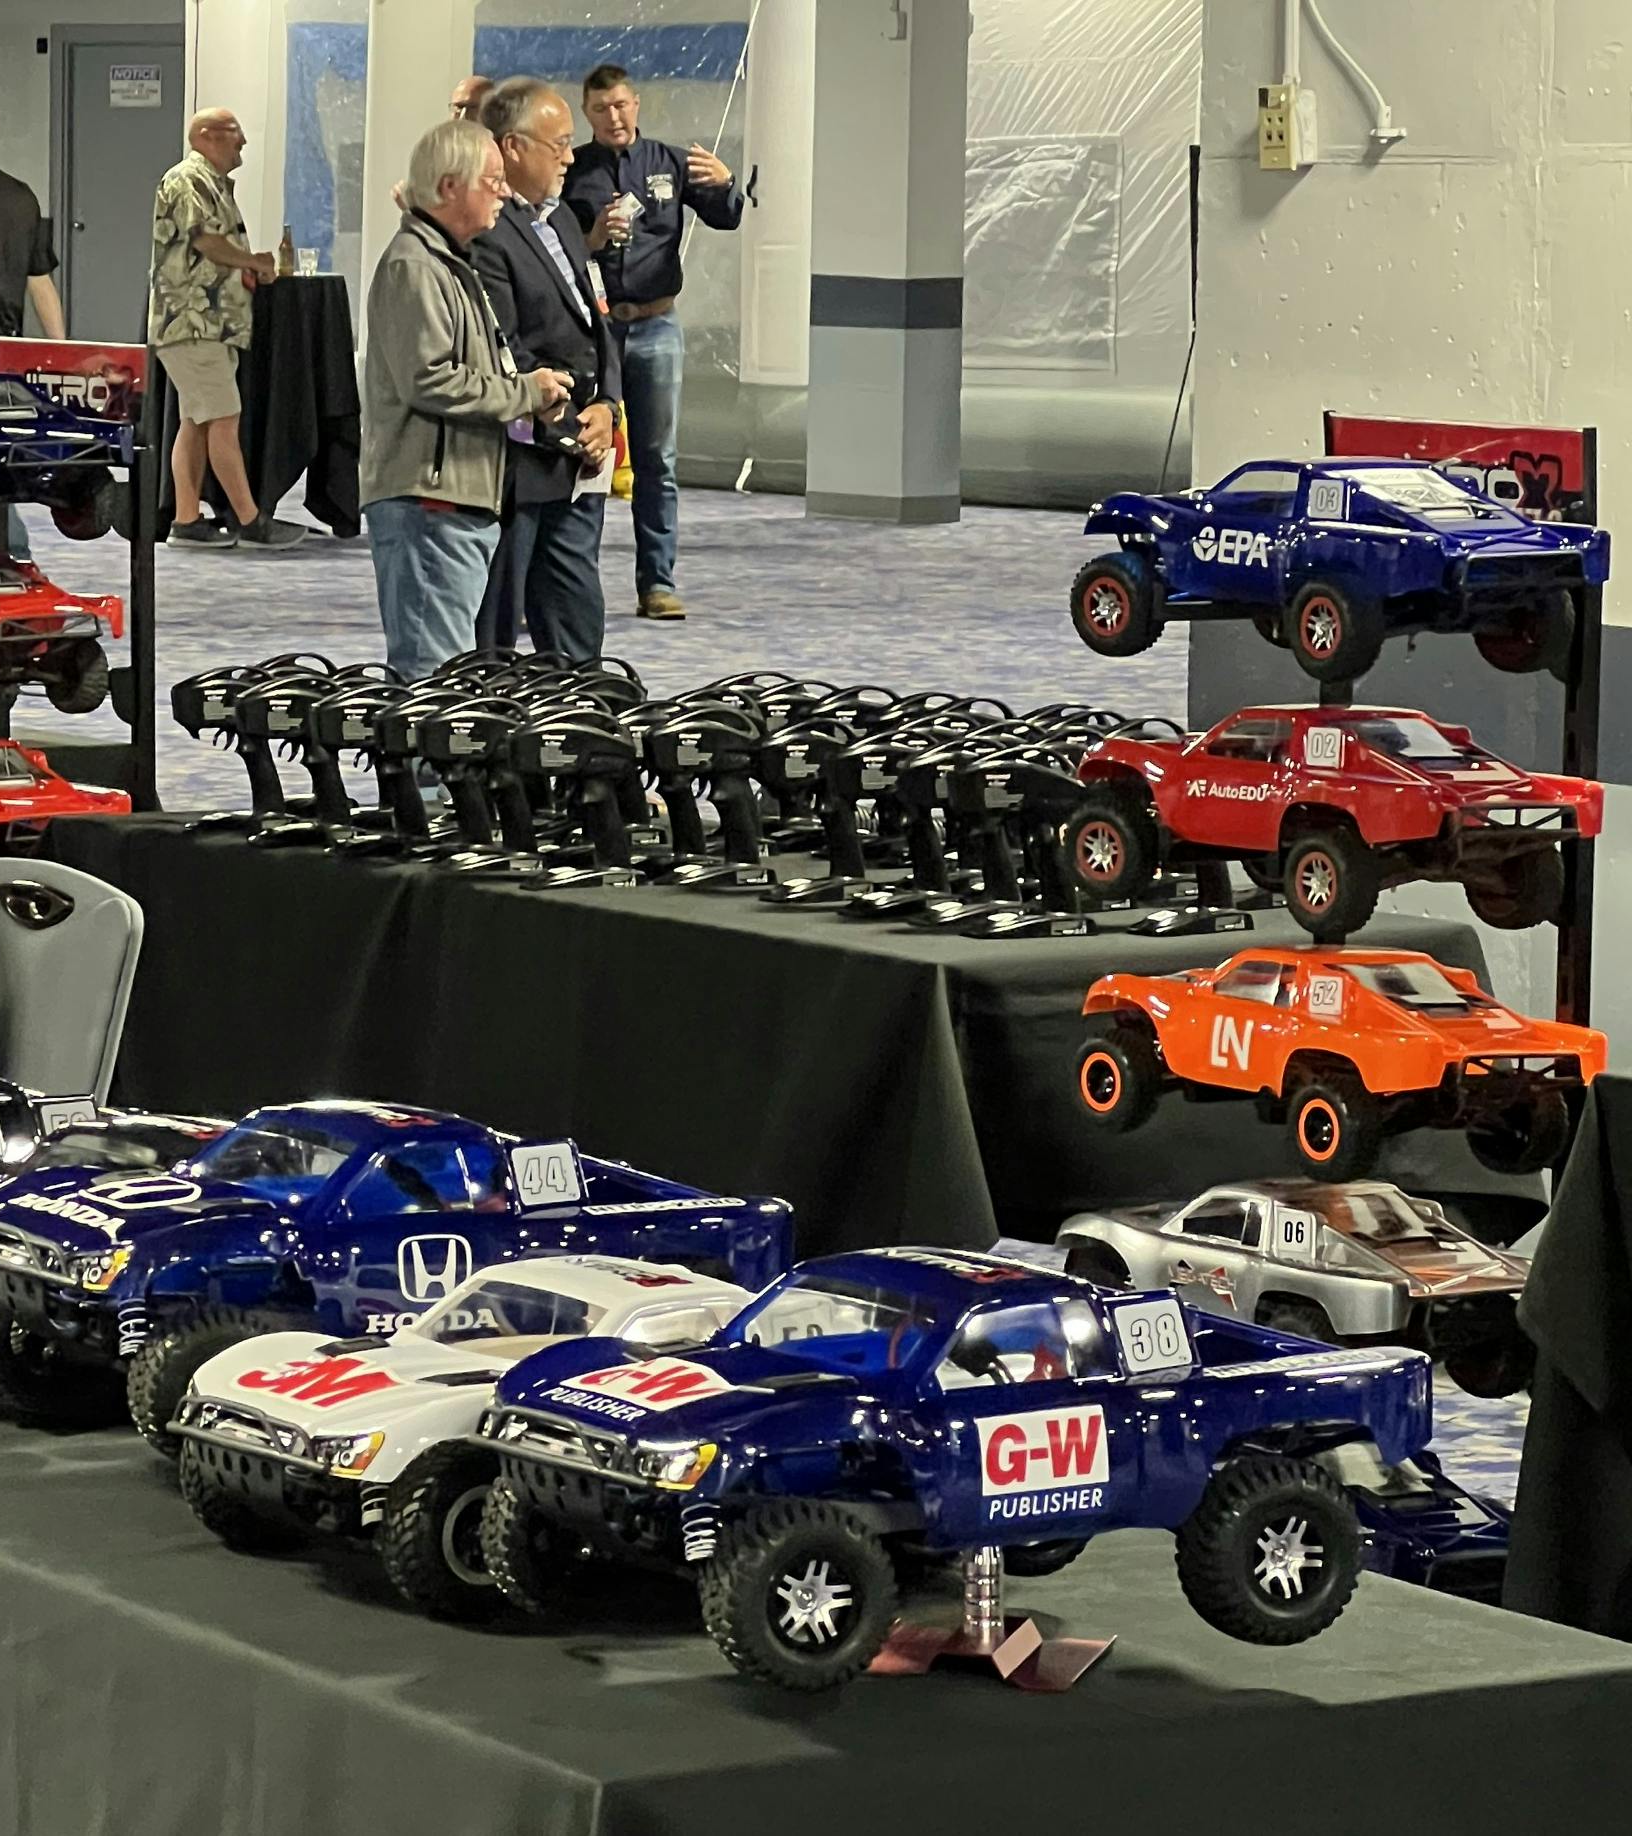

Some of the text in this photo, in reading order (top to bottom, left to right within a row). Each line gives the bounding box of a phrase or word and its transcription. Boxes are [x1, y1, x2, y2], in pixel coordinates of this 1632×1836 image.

[1315, 485, 1339, 513] 03
[1217, 530, 1270, 568] EPA
[1310, 731, 1336, 759] 02
[1311, 980, 1338, 1006] 52
[521, 1156, 568, 1195] 44
[8, 1192, 126, 1244] HONDA
[1284, 1220, 1305, 1244] 06
[365, 1308, 499, 1334] HODA
[1130, 1313, 1180, 1362] 38
[236, 1356, 399, 1408] 3M
[541, 1385, 648, 1423] PUBLISHER
[985, 1415, 1102, 1486] G-W
[988, 1487, 1104, 1520] PUBLISHER
